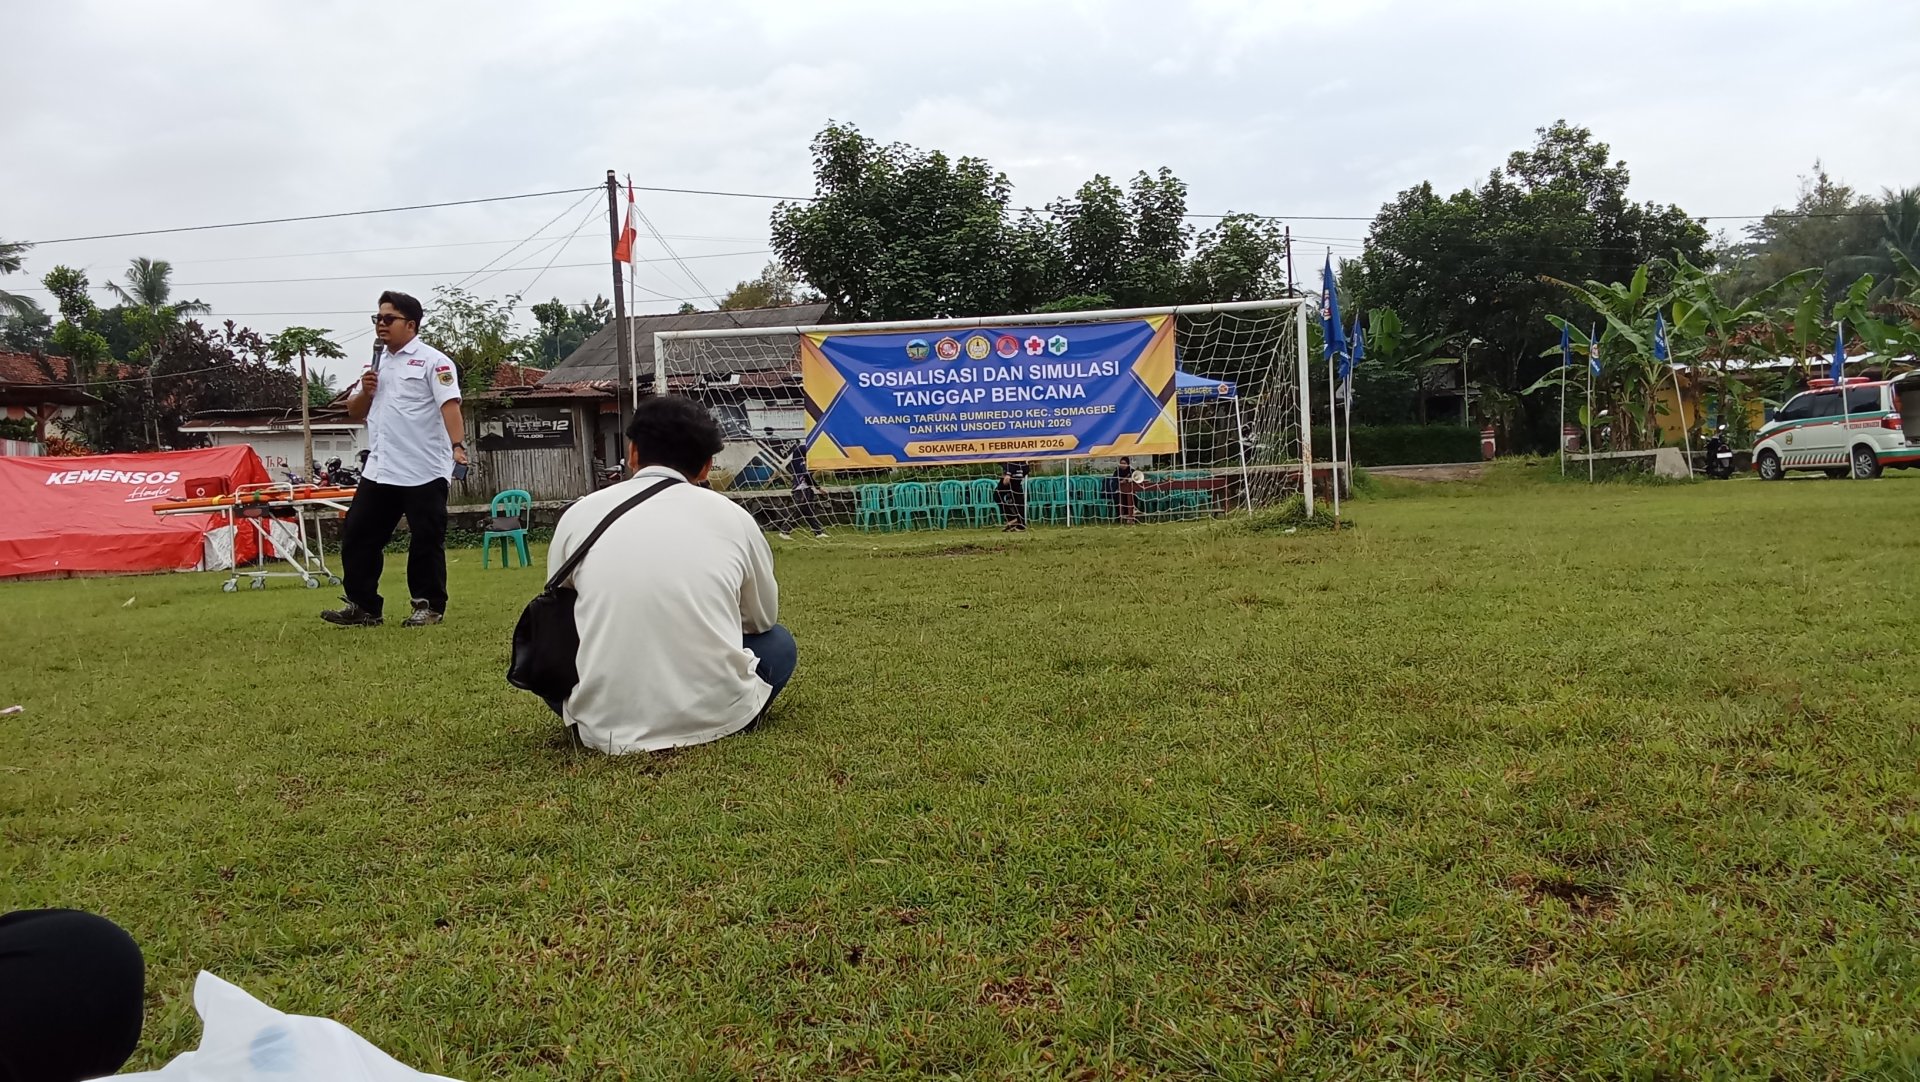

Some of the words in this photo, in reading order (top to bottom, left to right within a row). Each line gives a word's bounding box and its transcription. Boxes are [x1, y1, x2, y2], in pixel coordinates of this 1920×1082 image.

[858, 367, 977, 388] SOSIALISASI
[983, 365, 1023, 382] DAN
[1029, 361, 1120, 380] SIMULASI
[893, 388, 986, 407] TANGGAP
[992, 384, 1086, 403] BENCANA
[864, 414, 911, 425] KARANG
[913, 412, 958, 423] TARUNA
[960, 409, 1023, 421] BUMIREDJO
[1025, 408, 1051, 418] KEC.
[1054, 404, 1116, 417] SOMAGEDE
[909, 425, 932, 434] DAN
[935, 423, 958, 432] KKN
[961, 421, 1006, 432] UNSOED
[1009, 420, 1045, 430] TAHUN
[1047, 418, 1072, 428] 2026
[918, 444, 978, 454] SOKAWERA,
[989, 440, 1037, 450] FEBRUARI
[1040, 438, 1065, 448] 2026
[46, 469, 181, 485] KEMENSOS
